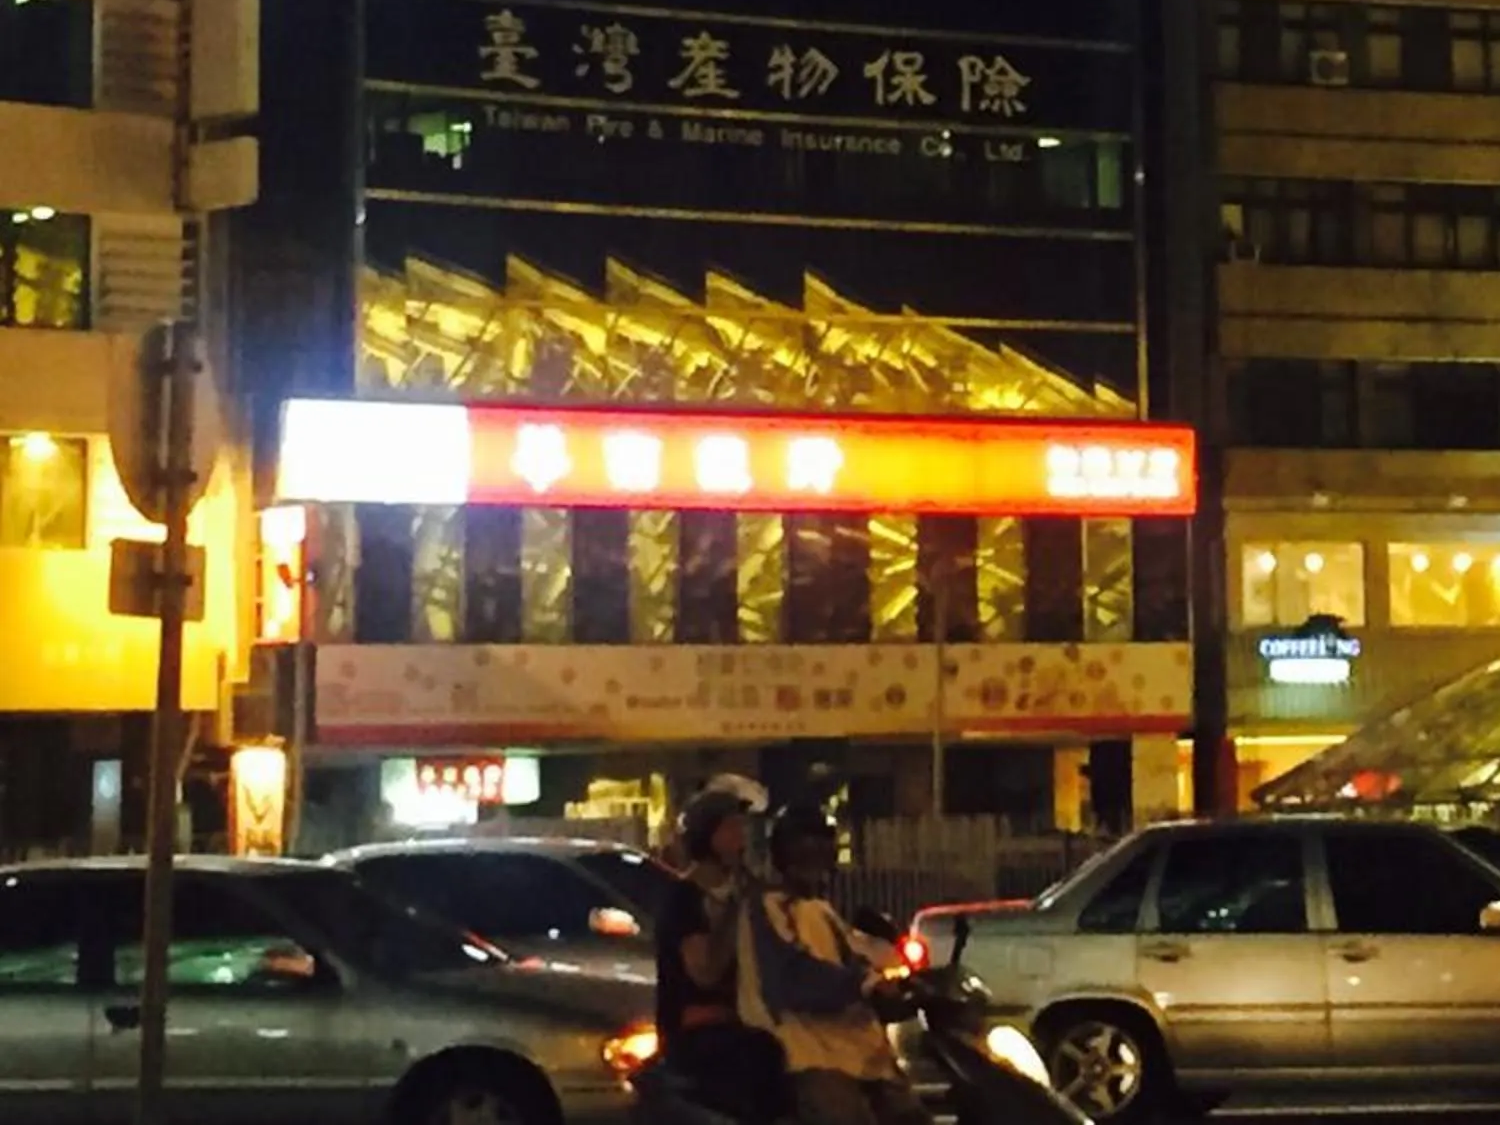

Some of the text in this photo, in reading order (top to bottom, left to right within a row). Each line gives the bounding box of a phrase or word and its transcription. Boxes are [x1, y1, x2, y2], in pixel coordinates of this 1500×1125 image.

[483, 105, 571, 133] Taiwan
[646, 119, 664, 140] &
[681, 120, 764, 148] Marine
[780, 128, 902, 156] Insurance
